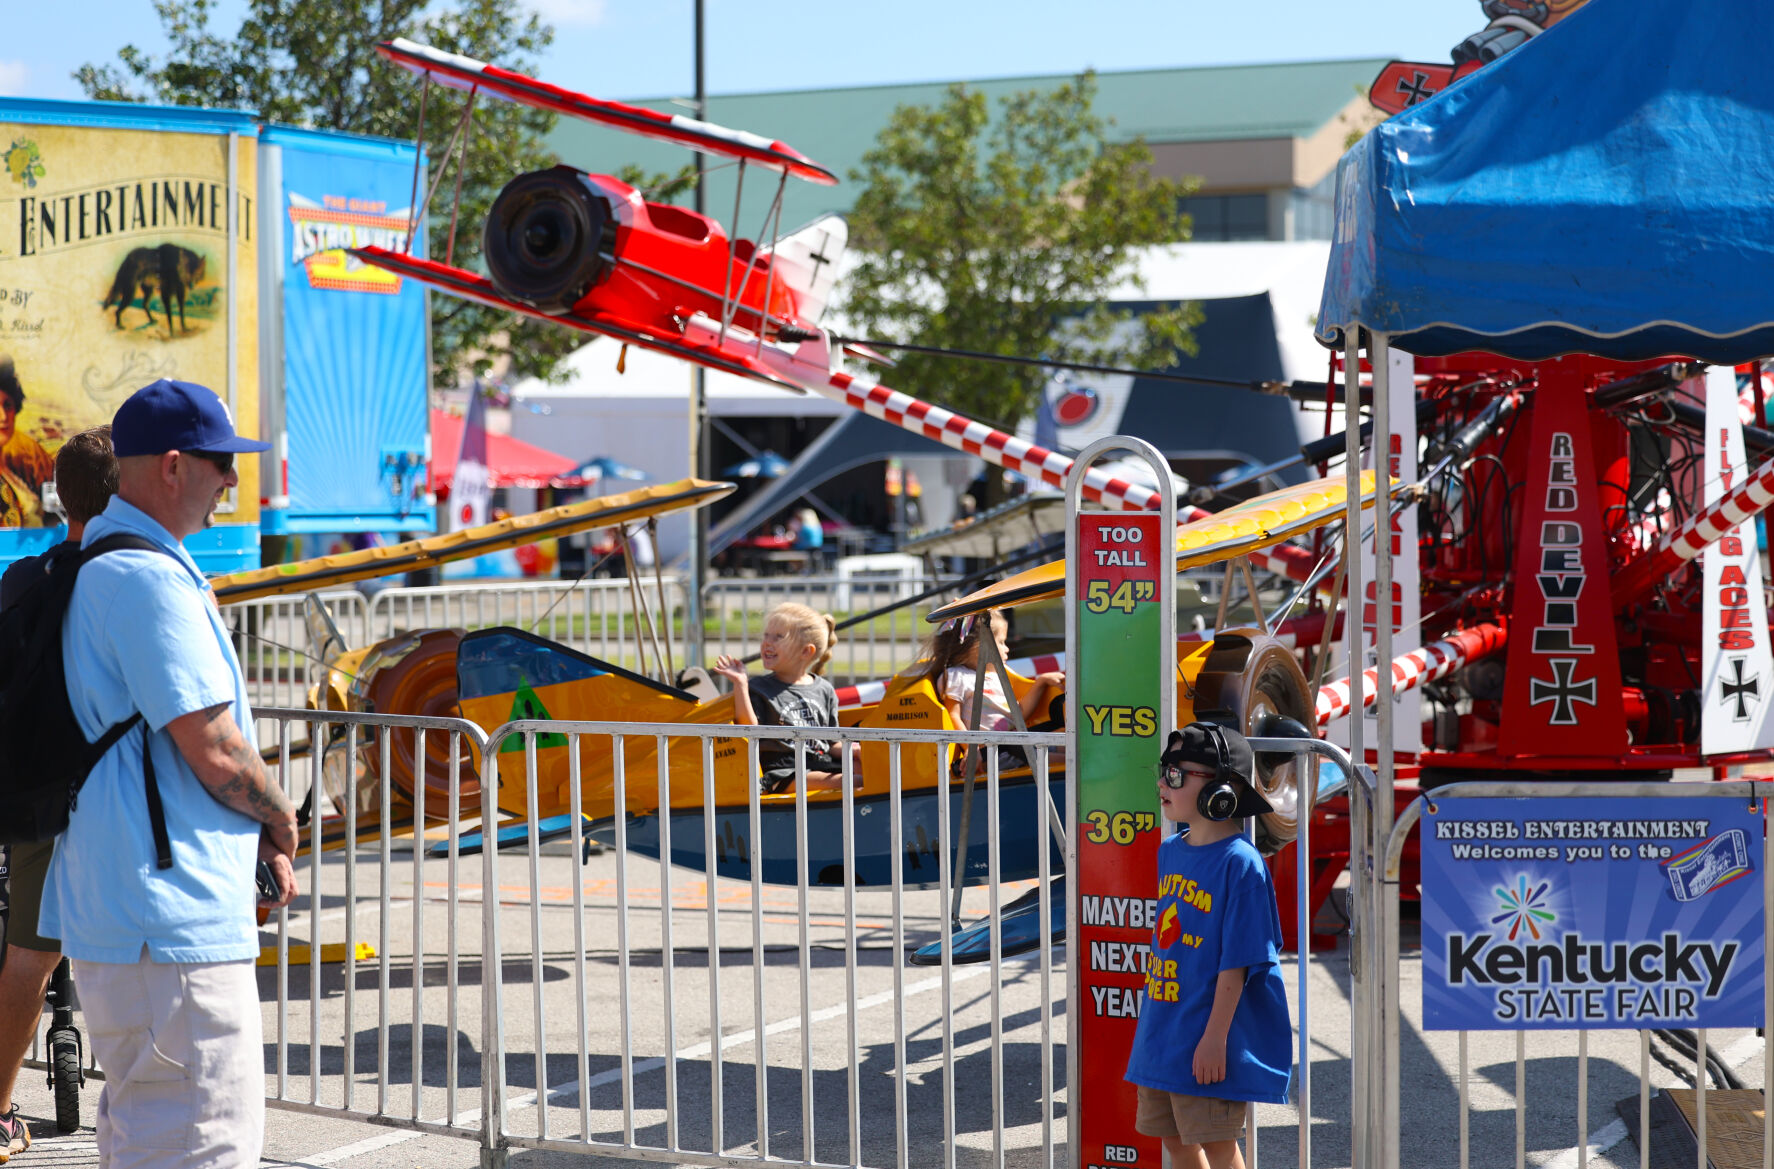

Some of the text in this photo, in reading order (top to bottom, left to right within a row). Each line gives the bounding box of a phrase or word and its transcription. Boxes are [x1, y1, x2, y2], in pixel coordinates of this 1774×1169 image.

[1719, 428, 1743, 556] FLYG
[1098, 526, 1143, 544] TOO
[1532, 432, 1595, 654] RED DEVIL
[1094, 550, 1147, 567] TALL
[1084, 705, 1158, 737] YES
[1436, 820, 1710, 840] KISSEL ENTERTAINMENT
[1453, 844, 1672, 862] Welcomes you to the
[1081, 895, 1158, 929] MAYBE
[1090, 940, 1151, 974] NEXT
[1450, 934, 1738, 997] Kentucky
[1497, 989, 1695, 1019] STATE FAIR
[1104, 1145, 1138, 1163] RED
